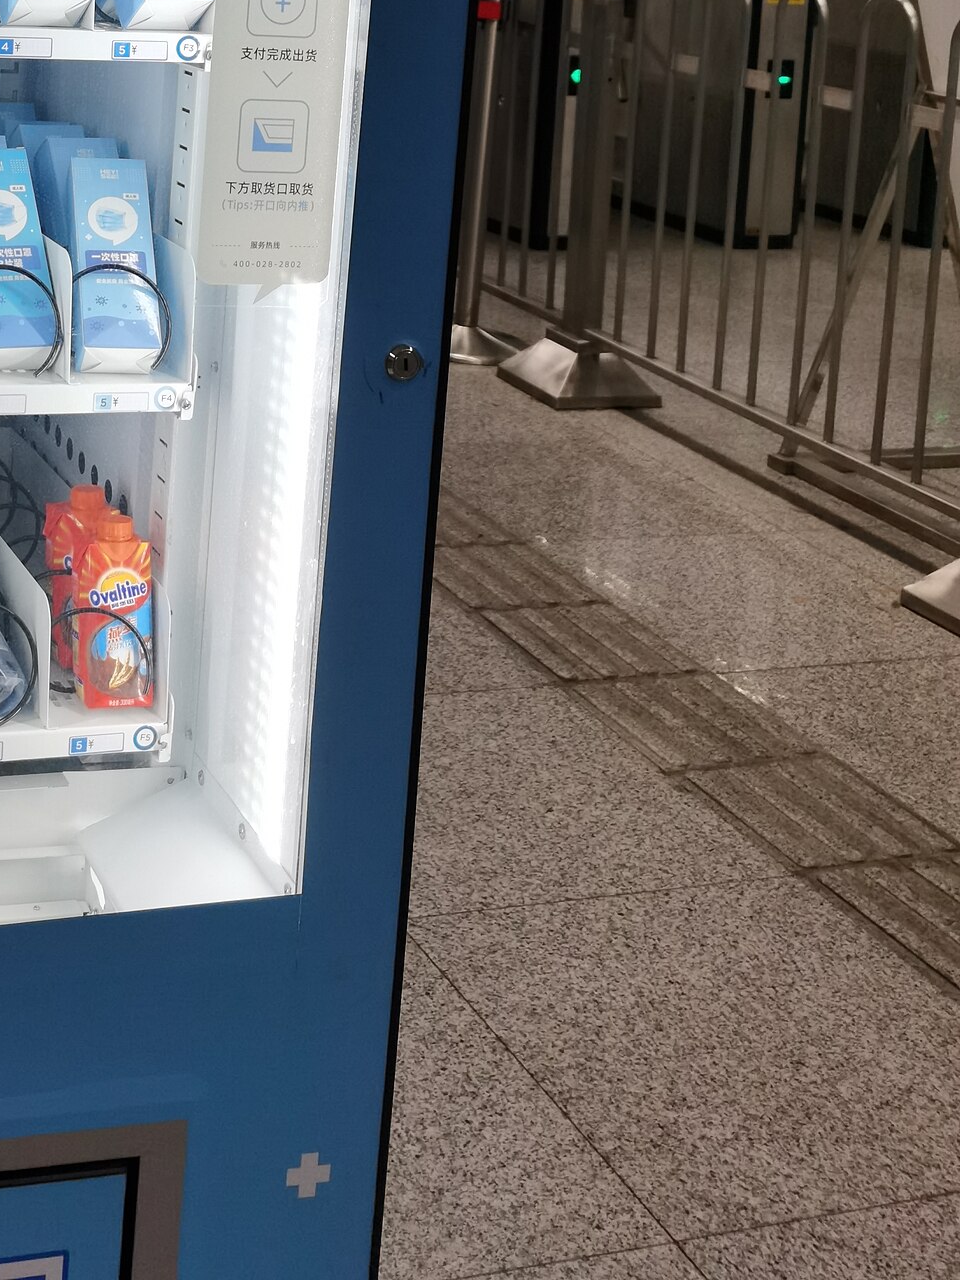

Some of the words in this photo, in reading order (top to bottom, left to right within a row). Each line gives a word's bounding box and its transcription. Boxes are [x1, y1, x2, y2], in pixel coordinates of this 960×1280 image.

[1, 42, 9, 52] 4
[118, 46, 126, 55] 5
[182, 43, 194, 52] F3
[240, 47, 317, 63] 支付完成出货
[226, 181, 314, 196] 下方取货口取货
[250, 241, 281, 249] 服务热线
[233, 260, 302, 268] 400-028-2802
[100, 397, 107, 408] 5
[161, 394, 172, 403] F4
[90, 580, 147, 607] Ovaltine
[75, 740, 83, 750] 5
